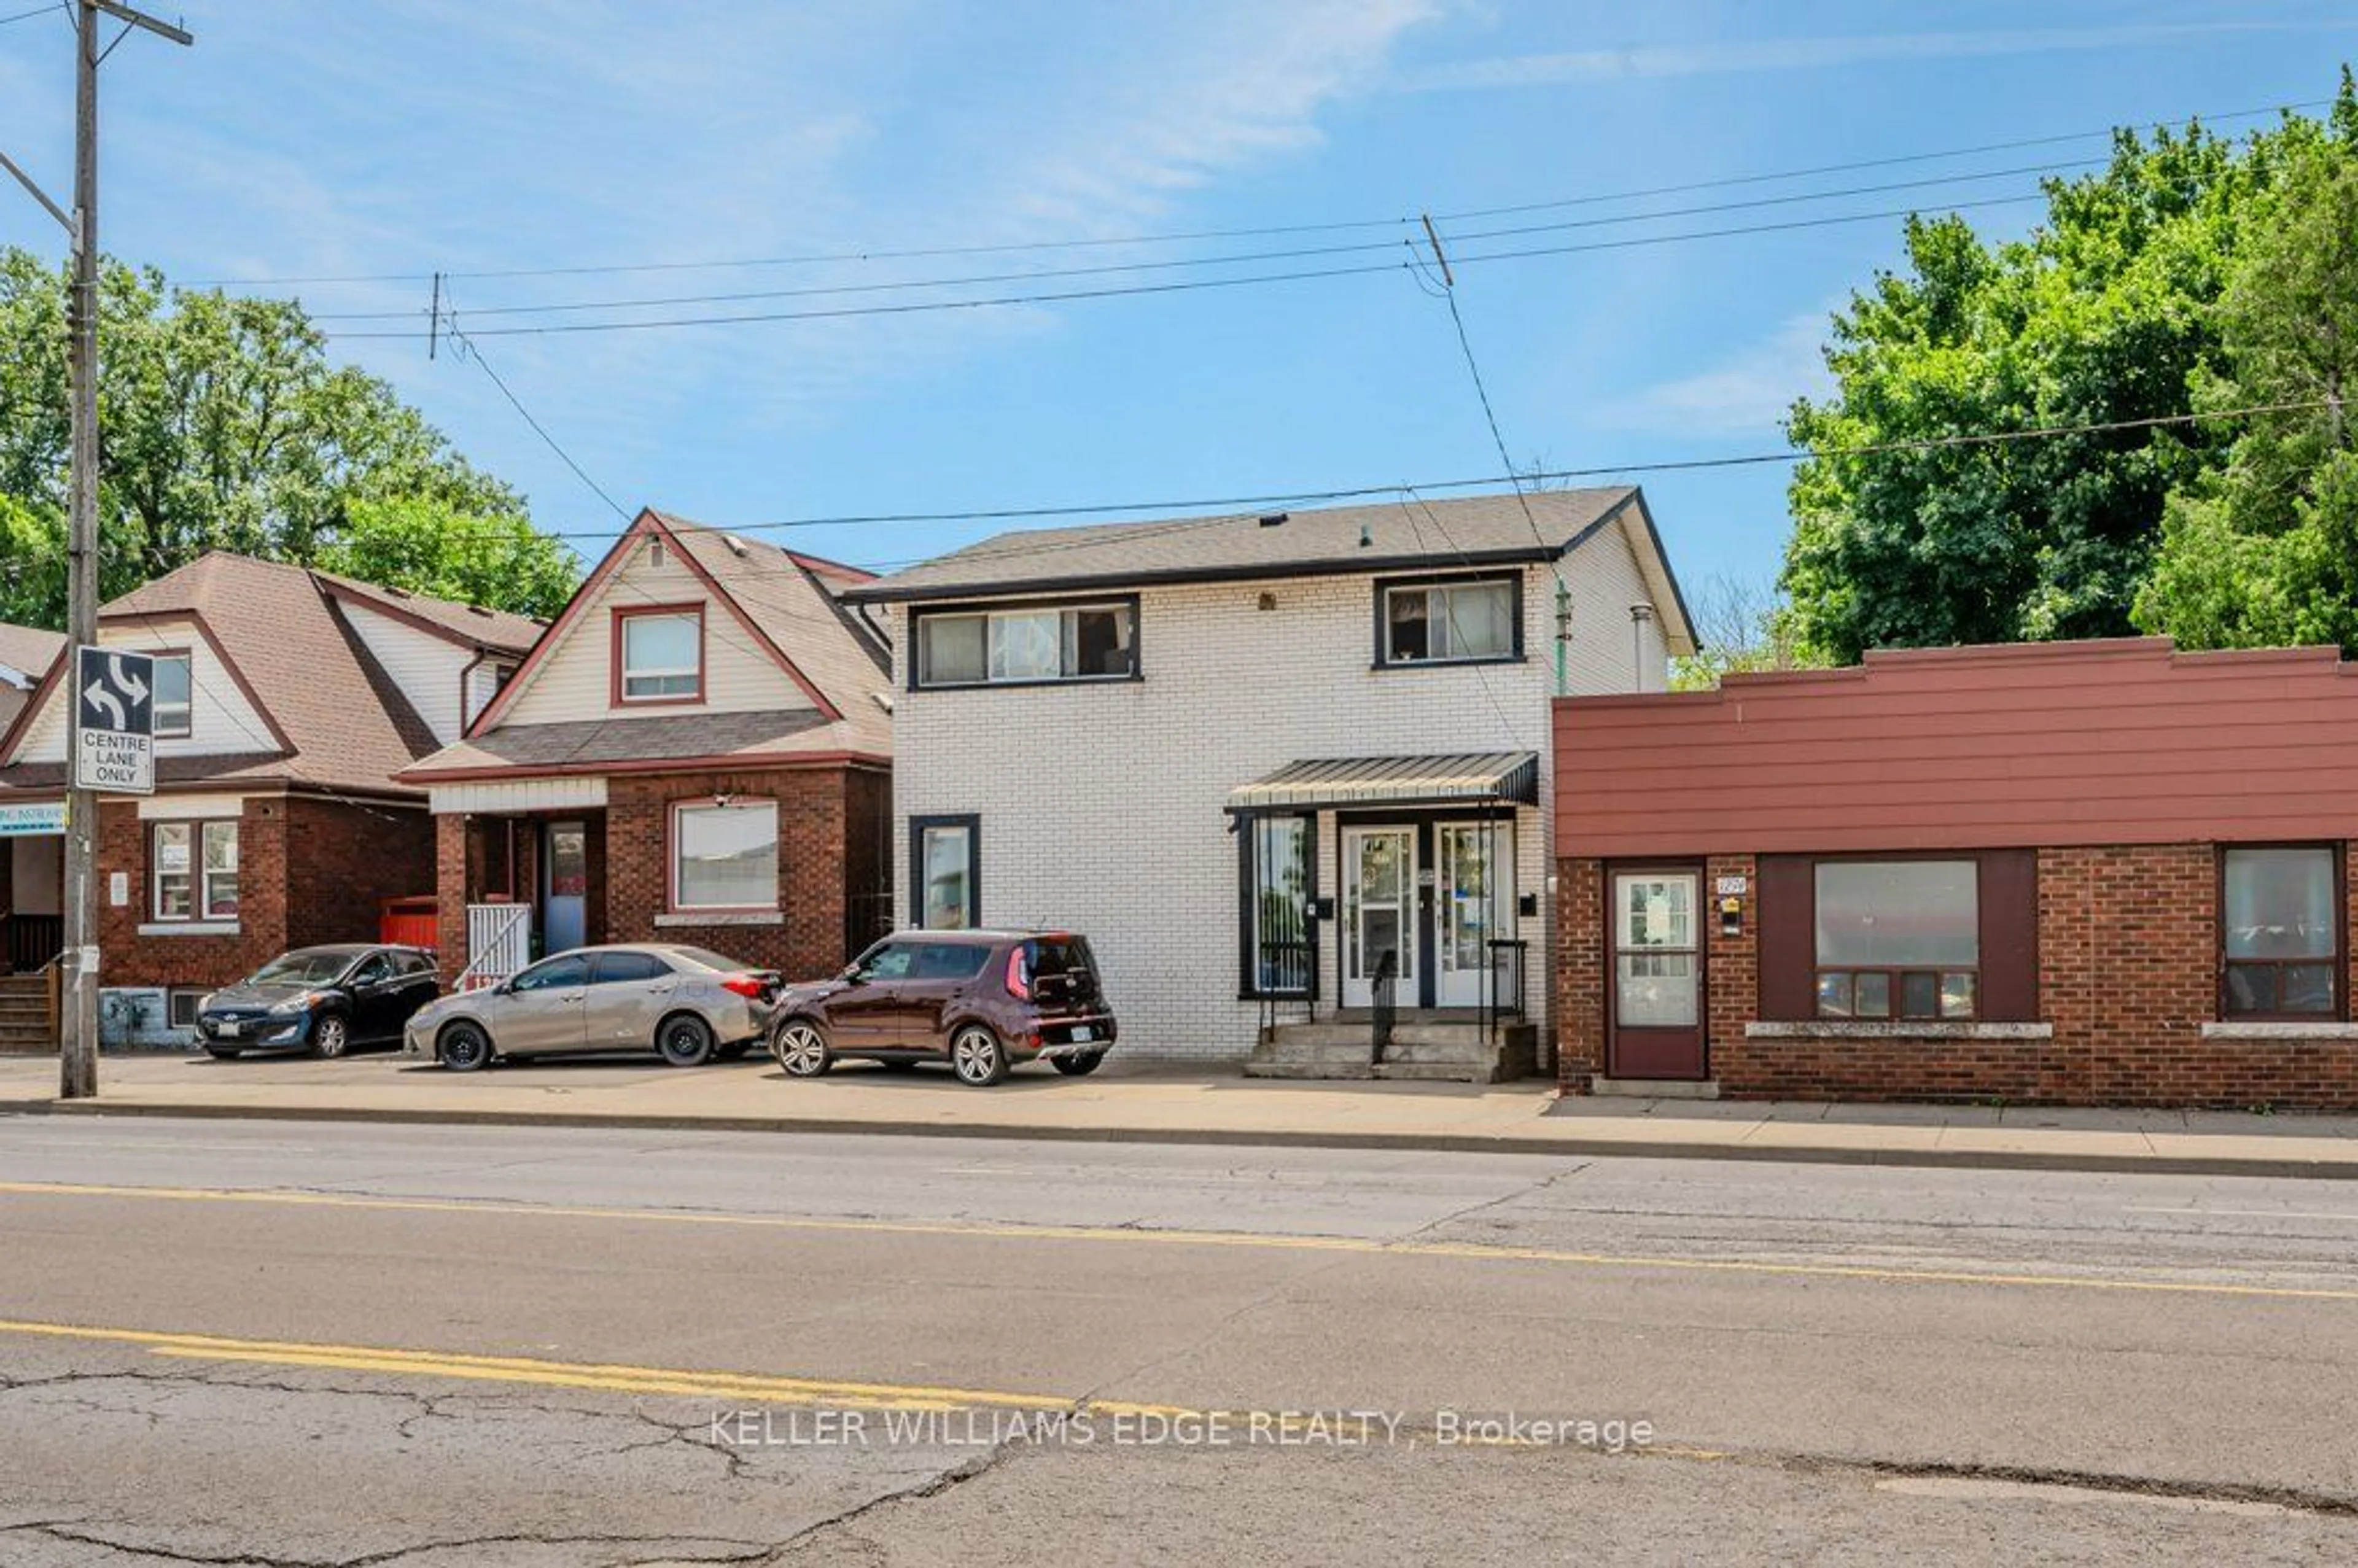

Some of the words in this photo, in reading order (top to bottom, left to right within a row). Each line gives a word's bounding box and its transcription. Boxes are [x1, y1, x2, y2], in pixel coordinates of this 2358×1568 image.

[85, 732, 148, 751] CENTRE
[96, 750, 137, 767] LANE
[96, 766, 137, 782] ONLY
